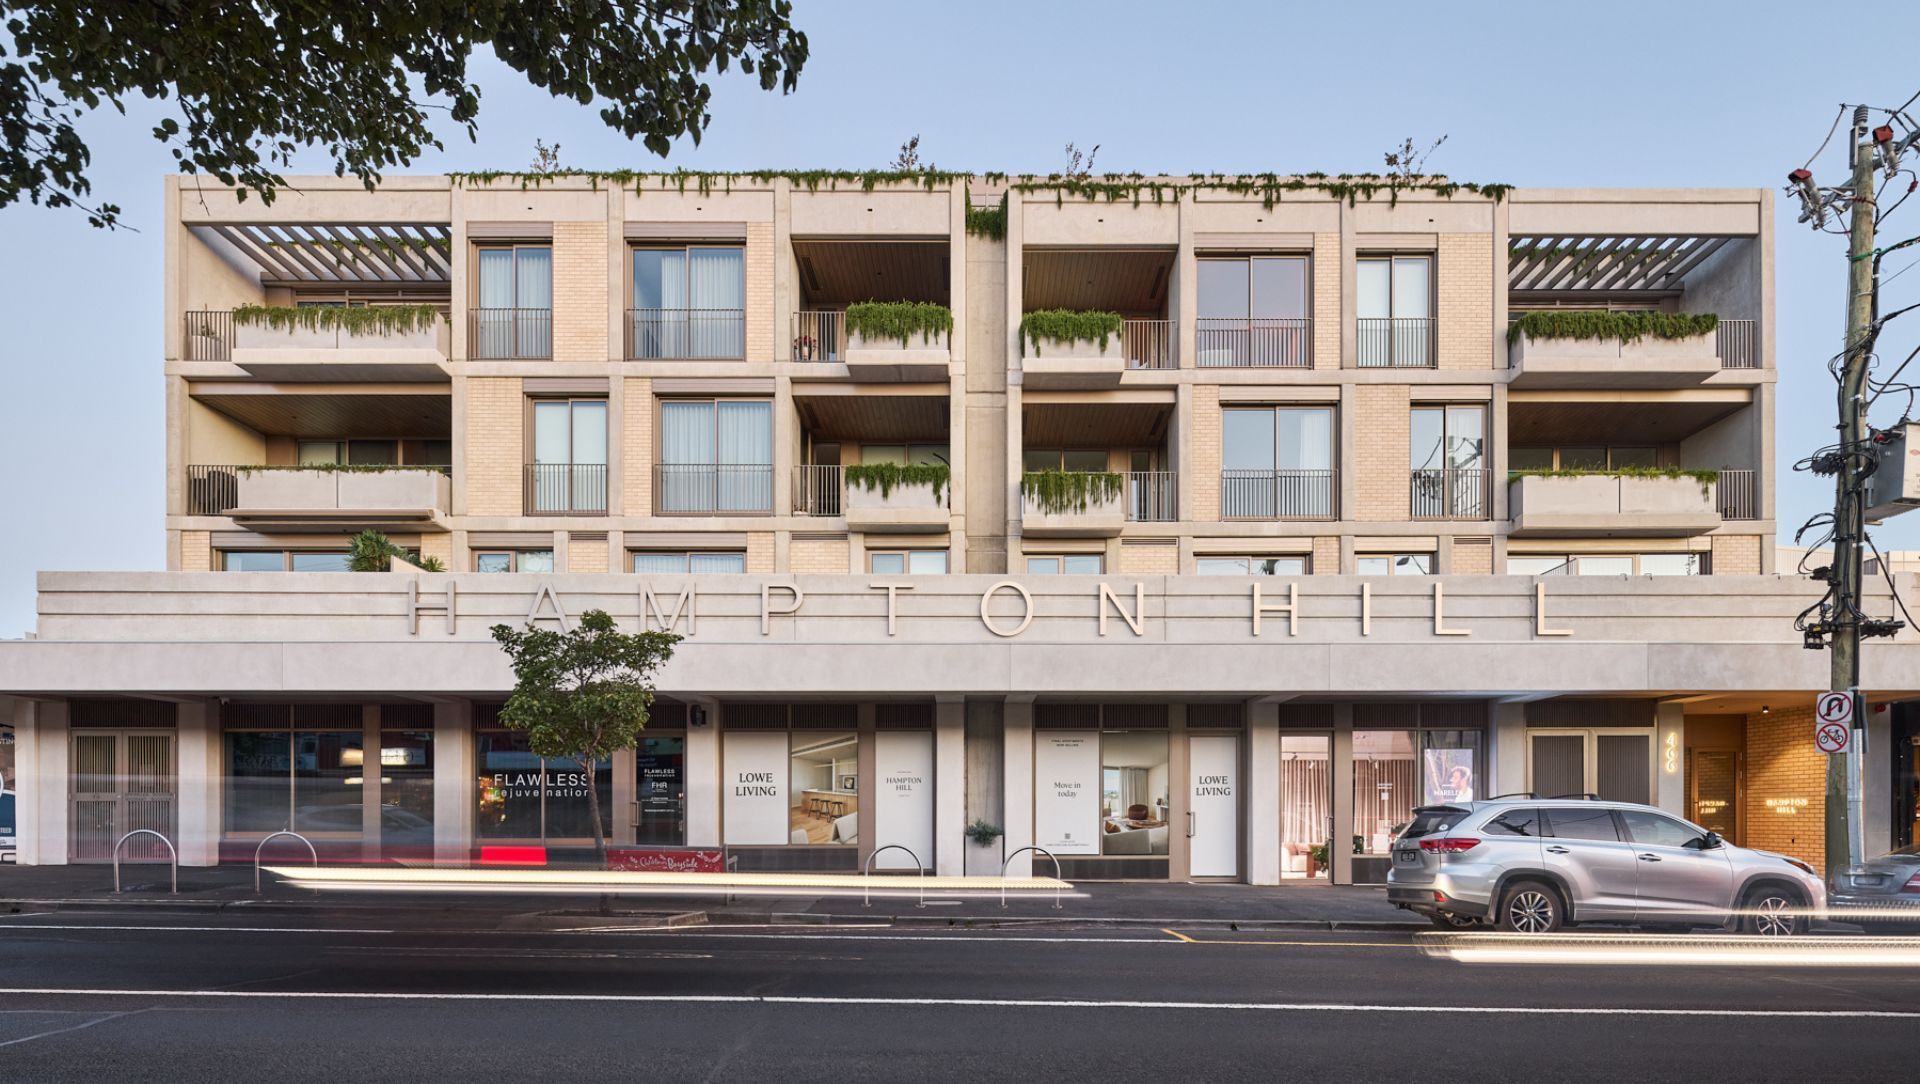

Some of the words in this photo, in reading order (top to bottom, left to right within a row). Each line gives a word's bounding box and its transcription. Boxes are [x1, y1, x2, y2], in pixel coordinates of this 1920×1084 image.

[408, 580, 1144, 637] HAMPTON
[1252, 582, 1574, 635] HILL
[1666, 732, 1678, 772] 466
[494, 774, 588, 786] FLAWLESS
[739, 772, 773, 783] LOWE
[1199, 776, 1228, 784] LOWE
[1074, 781, 1081, 789] in
[736, 786, 776, 796] LIVING
[1058, 790, 1077, 798] today
[1196, 787, 1231, 796] LIVING
